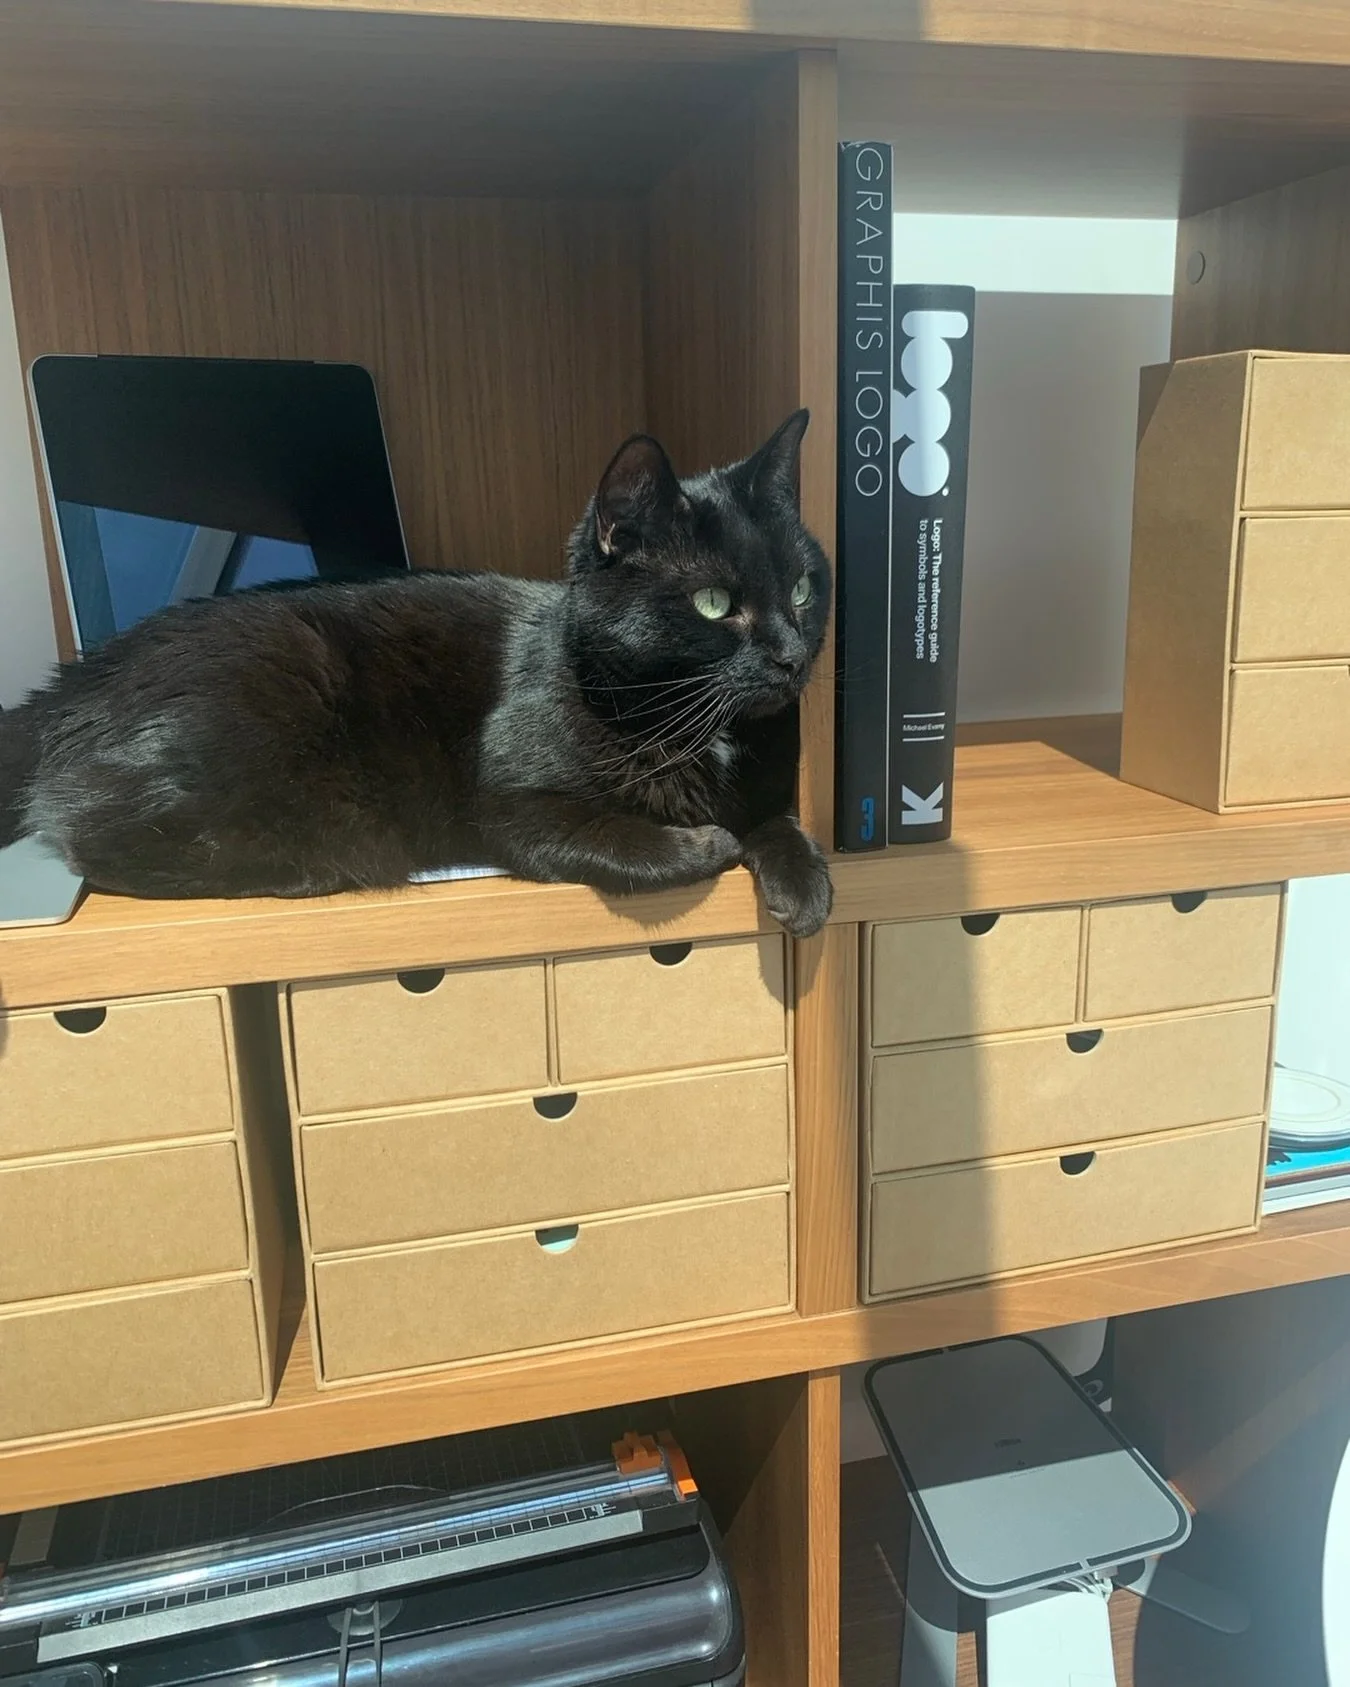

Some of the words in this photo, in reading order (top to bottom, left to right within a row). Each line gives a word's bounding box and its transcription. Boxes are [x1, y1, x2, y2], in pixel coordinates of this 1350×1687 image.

[855, 147, 884, 350] GRAPHIS
[855, 371, 884, 497] LOGO
[919, 519, 929, 531] to
[931, 518, 943, 552] Logo:
[917, 533, 928, 580] symbols
[932, 553, 943, 576] The
[917, 582, 928, 603] and
[930, 577, 942, 631] reference
[914, 605, 927, 660] logotypes
[928, 632, 940, 663] guide
[901, 781, 944, 826] K
